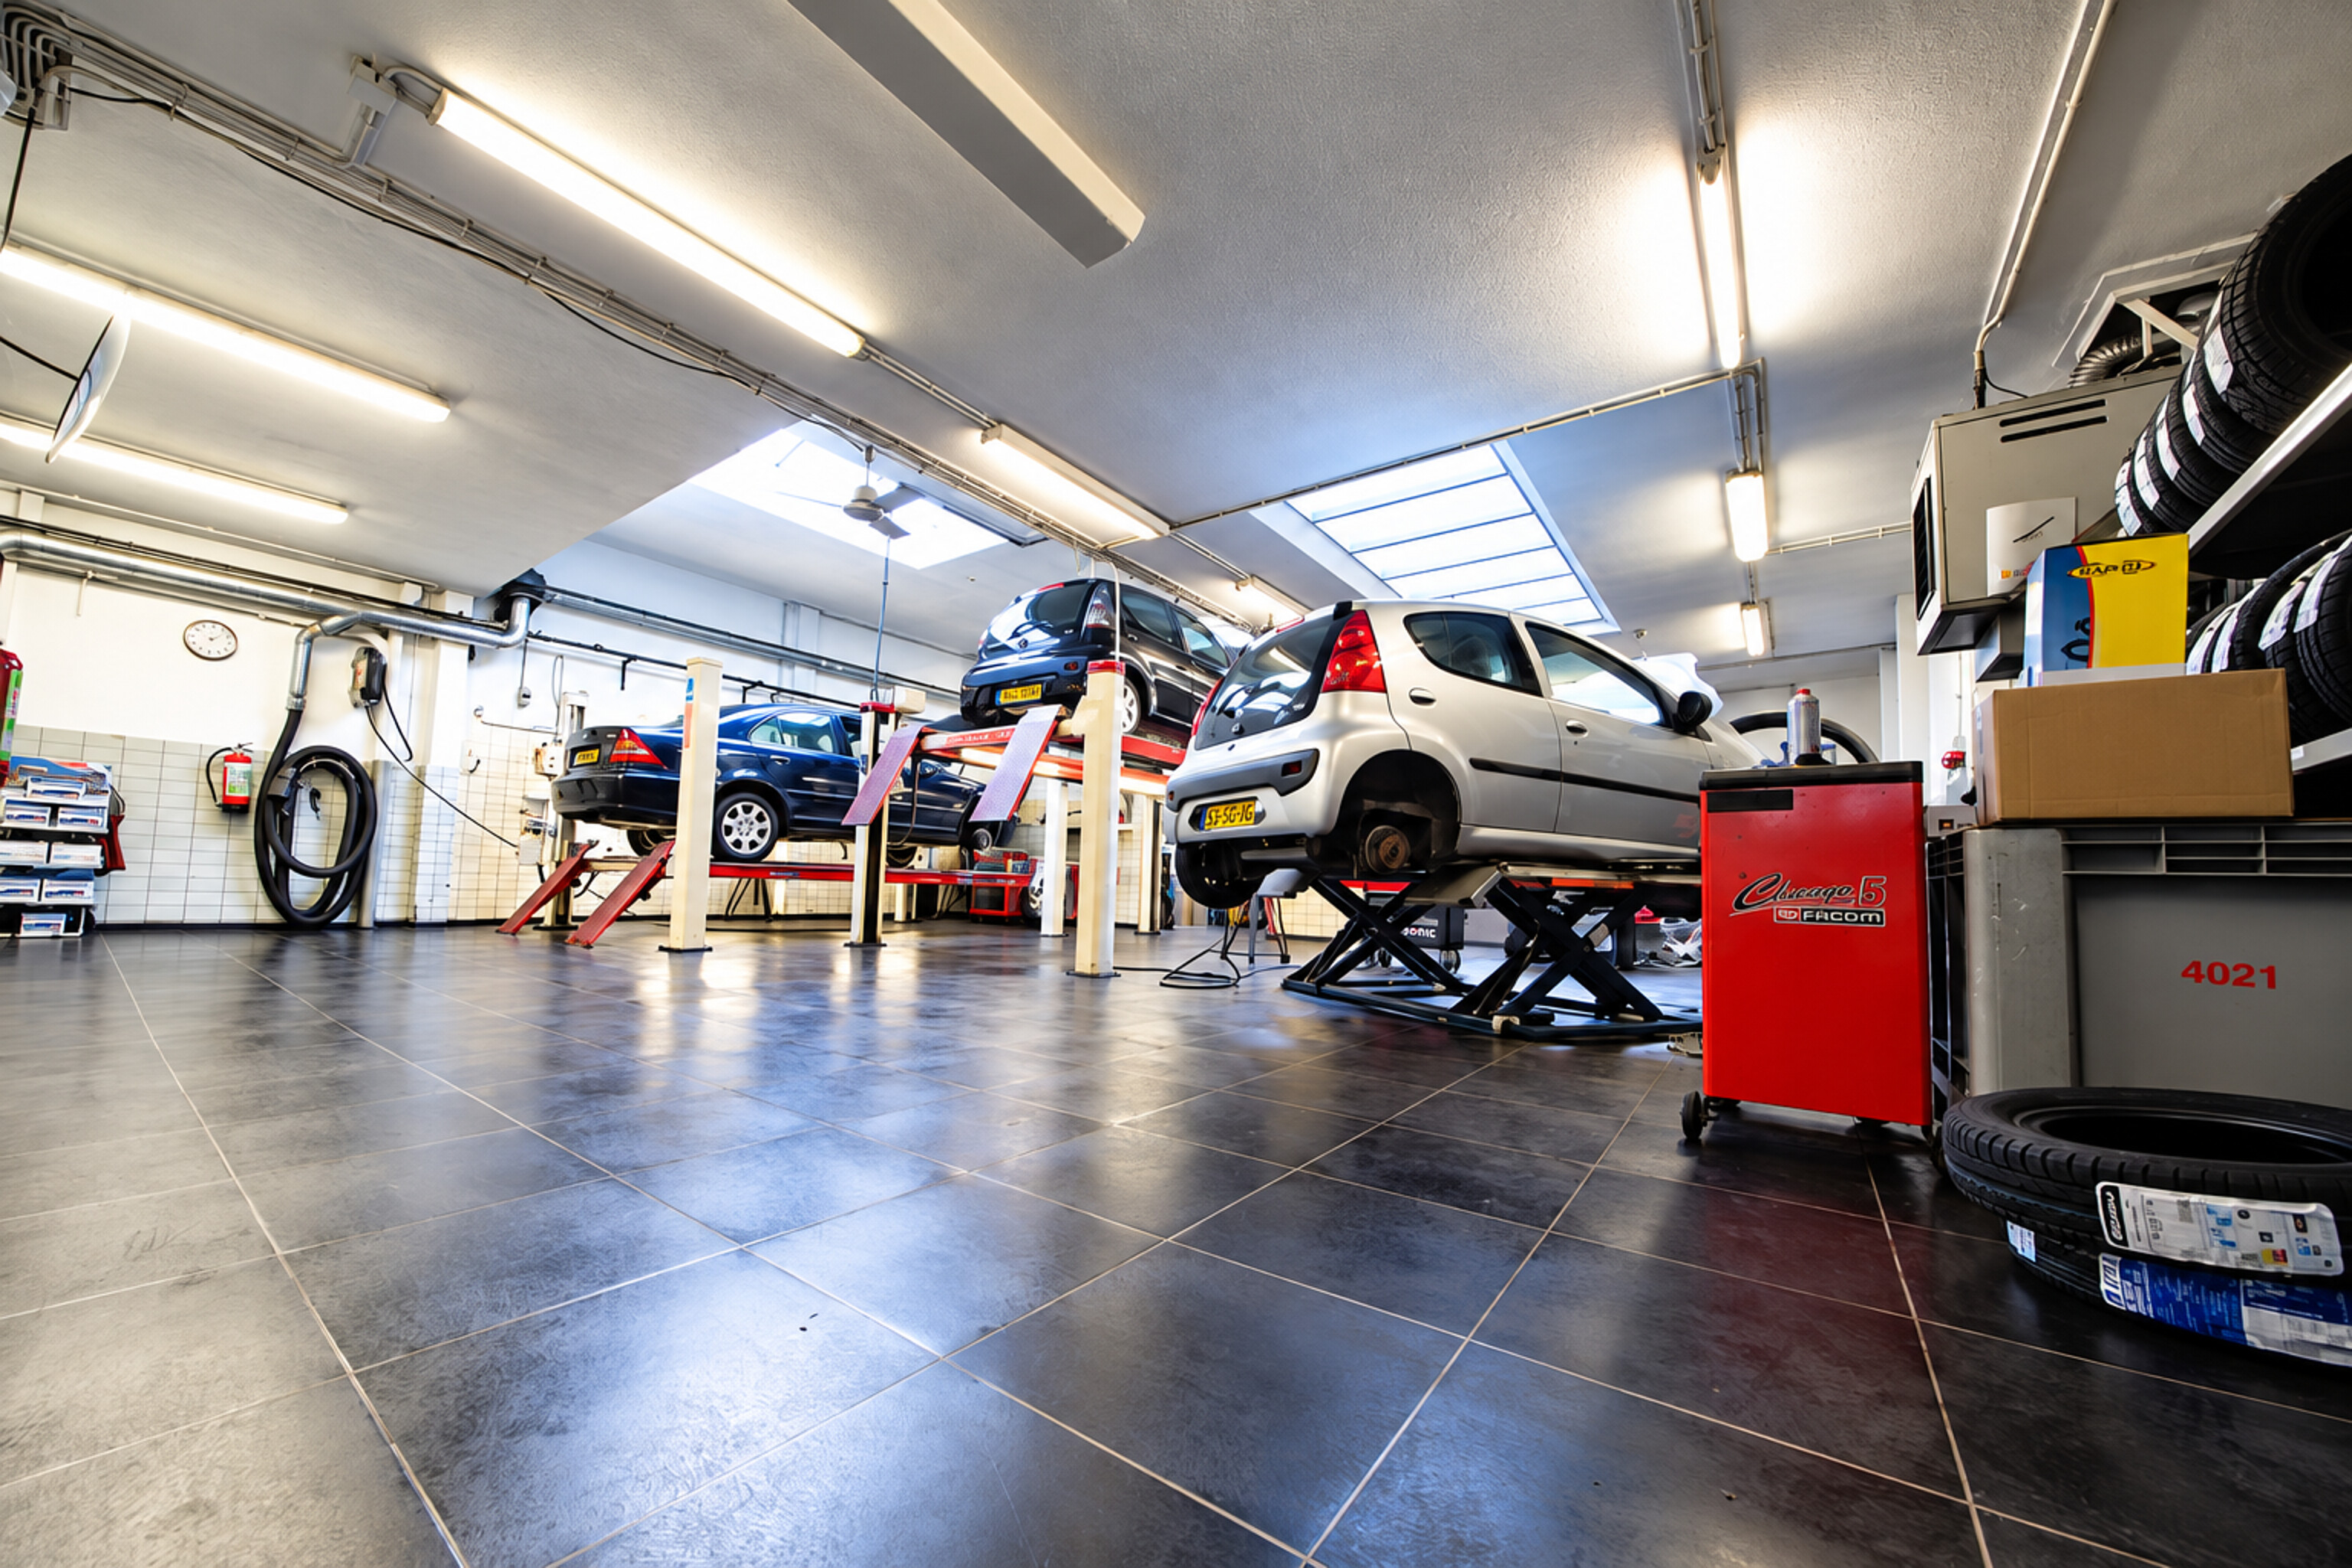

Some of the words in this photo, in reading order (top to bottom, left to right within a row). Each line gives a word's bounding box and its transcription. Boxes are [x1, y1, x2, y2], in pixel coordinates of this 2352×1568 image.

[1732, 872, 1857, 912] Chicago
[1858, 875, 1887, 907] 5
[1802, 909, 1882, 923] FACOM
[2180, 960, 2276, 989] 4021
